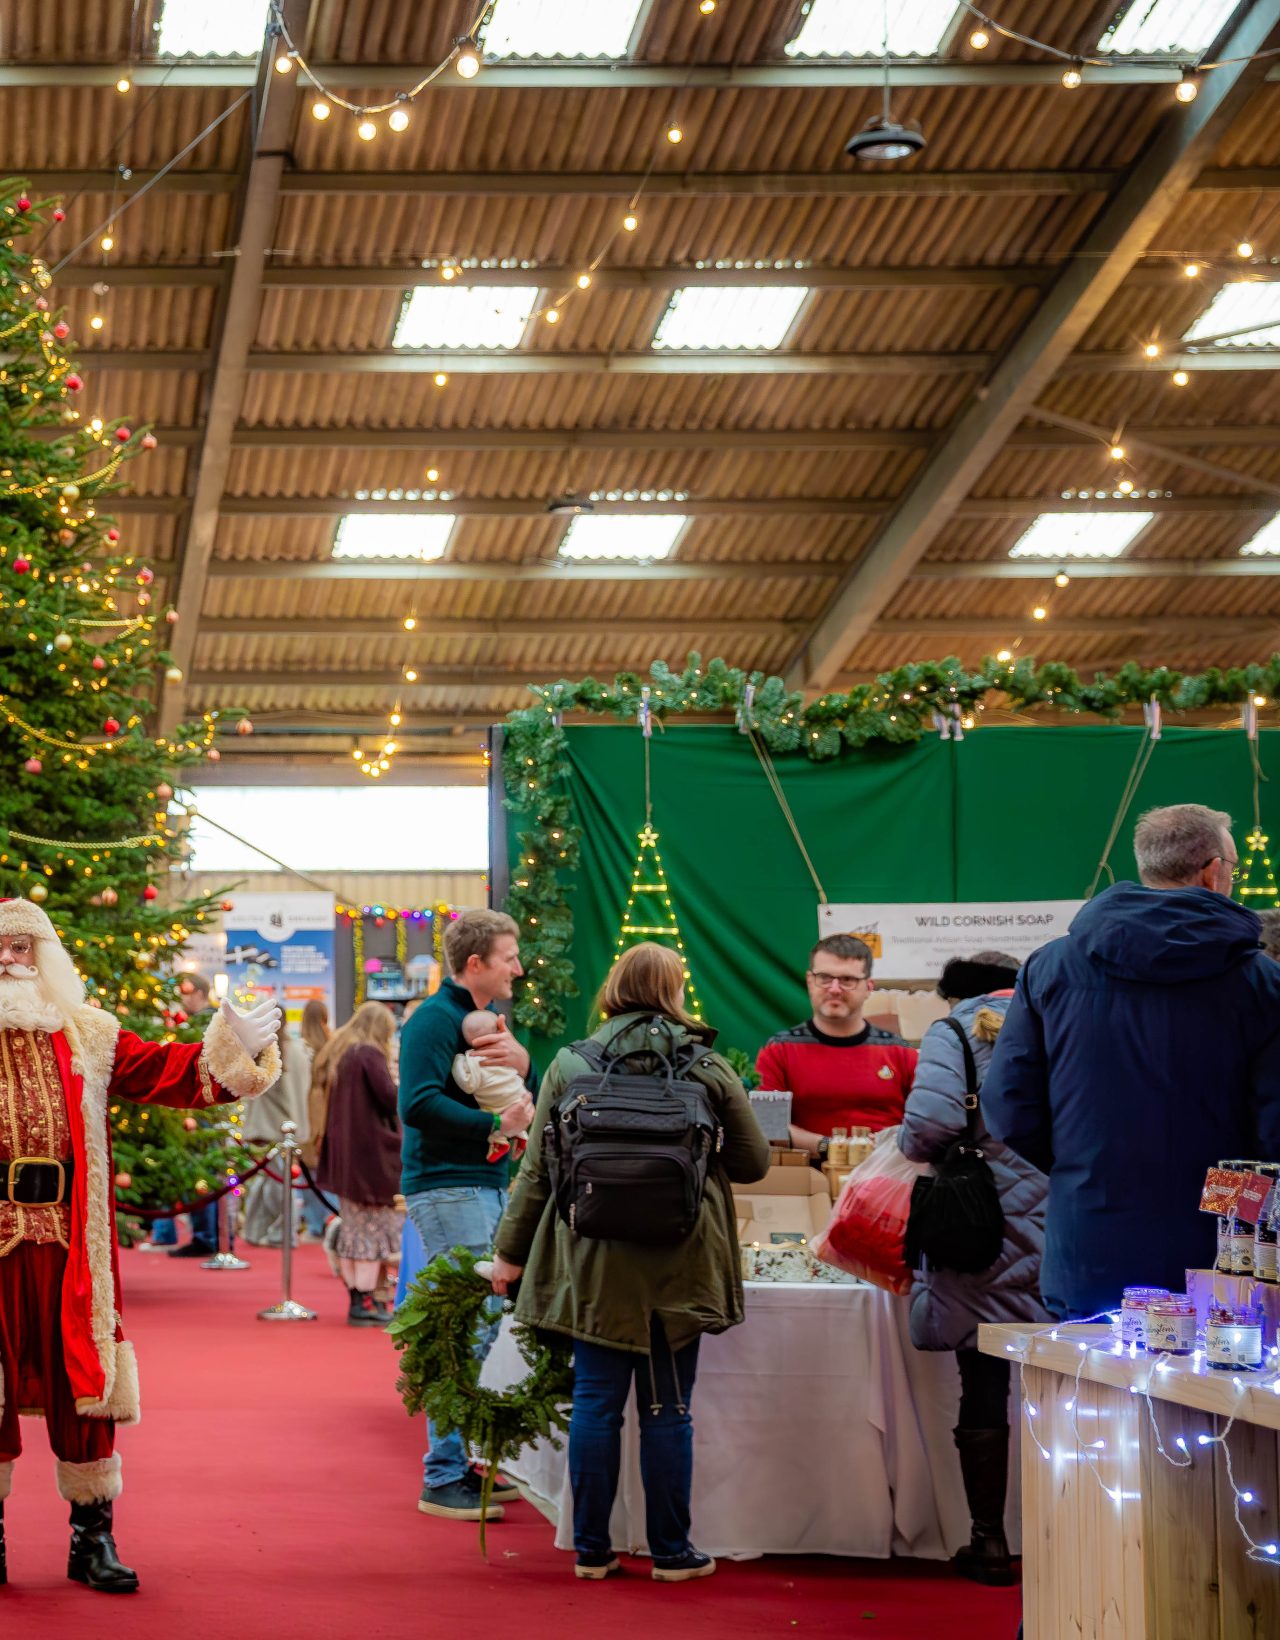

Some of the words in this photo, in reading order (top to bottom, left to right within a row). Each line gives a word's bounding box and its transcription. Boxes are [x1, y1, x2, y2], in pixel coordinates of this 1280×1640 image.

[915, 915, 951, 927] WILD
[953, 914, 1014, 927] CORNISH
[1016, 913, 1054, 925] SOAP
